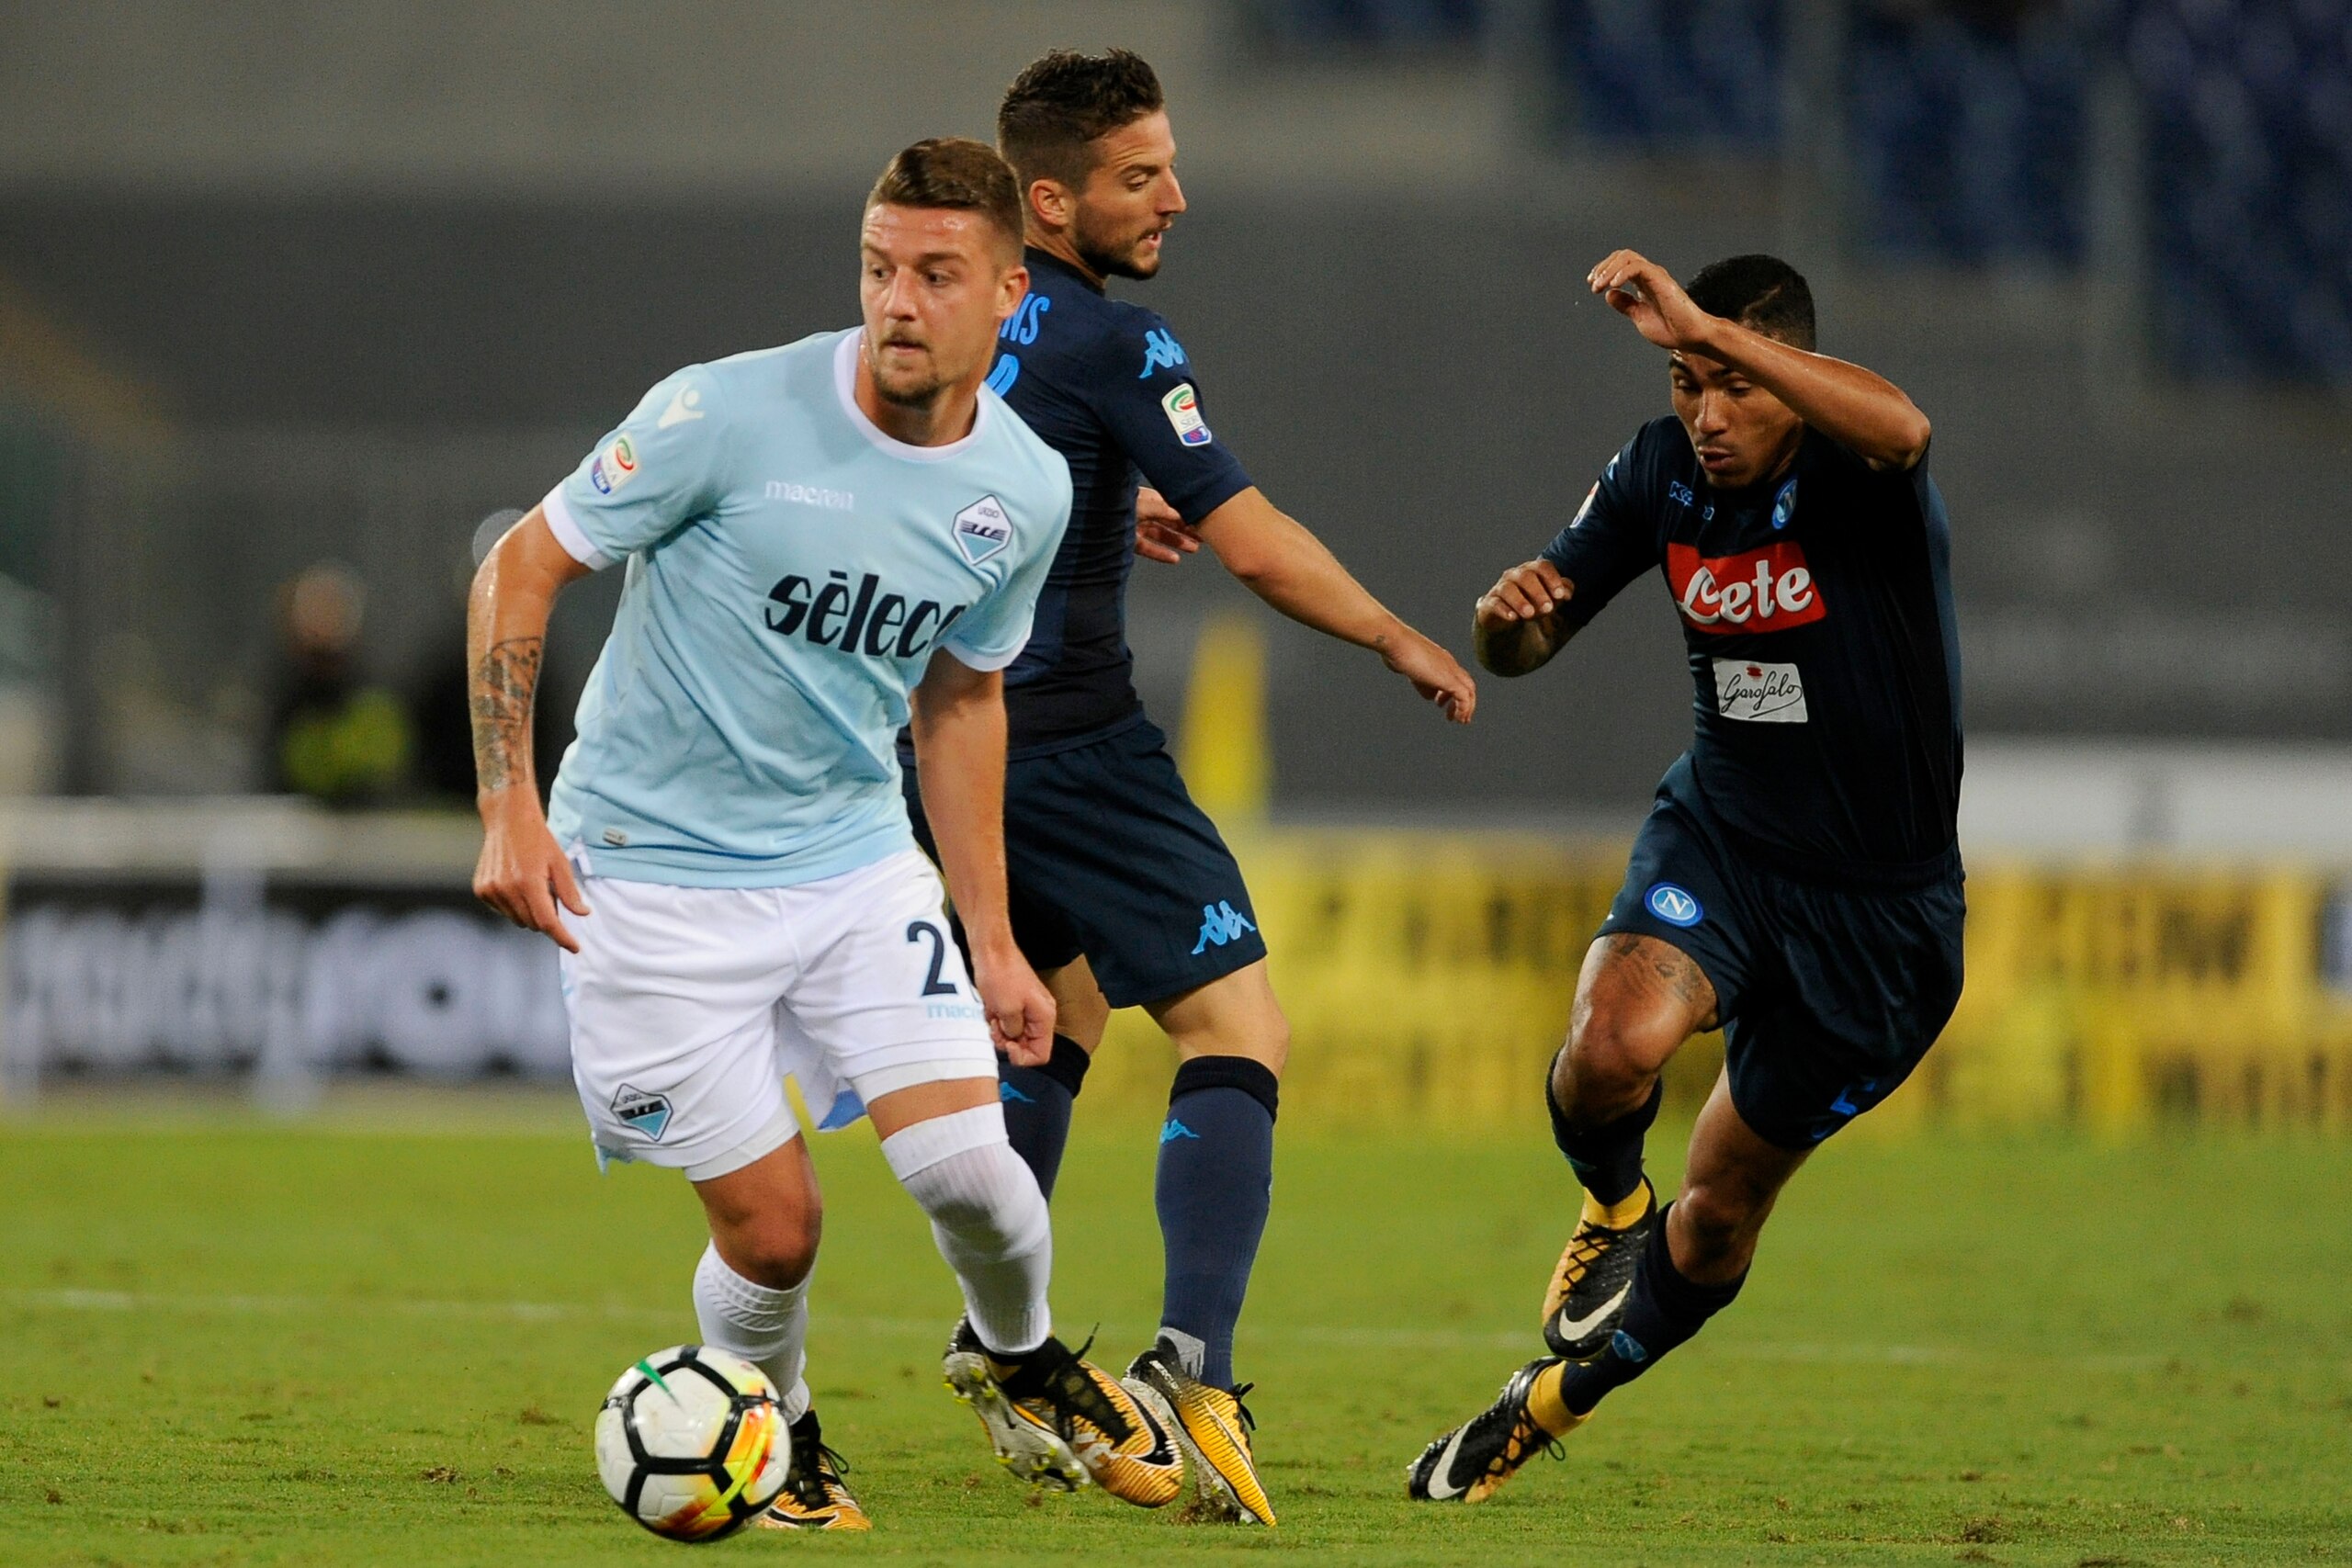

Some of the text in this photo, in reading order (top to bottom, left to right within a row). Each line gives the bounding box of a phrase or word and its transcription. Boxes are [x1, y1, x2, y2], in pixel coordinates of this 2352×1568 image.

[764, 480, 854, 511] macron
[1677, 559, 1813, 625] Lete
[1721, 671, 1803, 718] Garofalo
